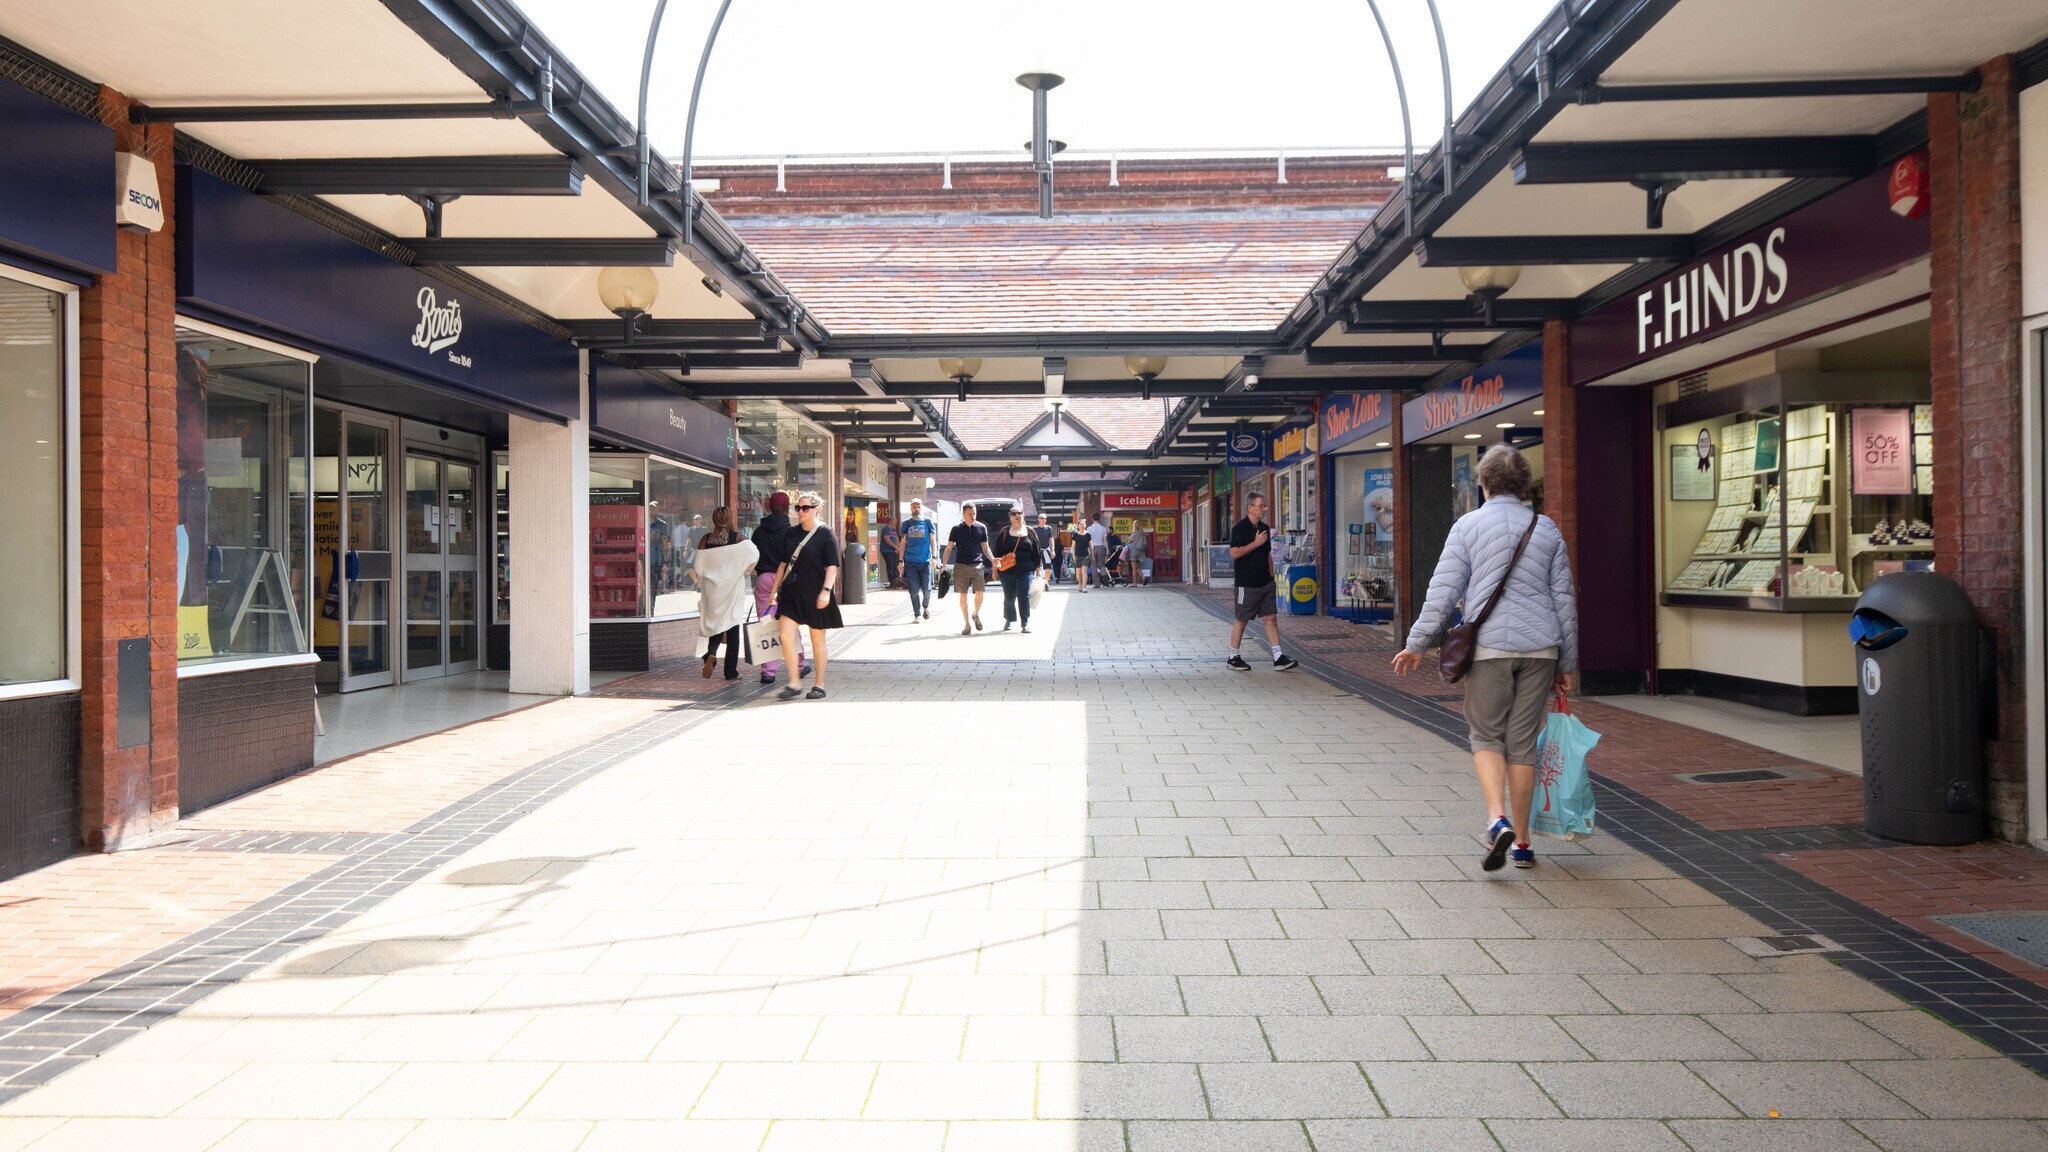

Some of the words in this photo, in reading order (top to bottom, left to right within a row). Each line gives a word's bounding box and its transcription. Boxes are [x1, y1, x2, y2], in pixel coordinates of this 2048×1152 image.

[129, 189, 160, 212] SECOM
[1638, 227, 1788, 355] F.HINDS
[411, 286, 462, 354] Boots
[448, 350, 461, 365] Since
[461, 355, 472, 369] 1849
[1424, 391, 1458, 432] Shoe
[1461, 374, 1504, 418] Zone
[670, 408, 686, 436] Beauty
[1326, 403, 1350, 441] Shoe
[1352, 392, 1381, 429] Zone
[1235, 438, 1254, 449] Boots
[1866, 434, 1899, 449] 50%
[1866, 450, 1898, 464] OFF
[1120, 496, 1161, 505] Iceland
[597, 510, 629, 520] benefit
[761, 635, 782, 650] DA
